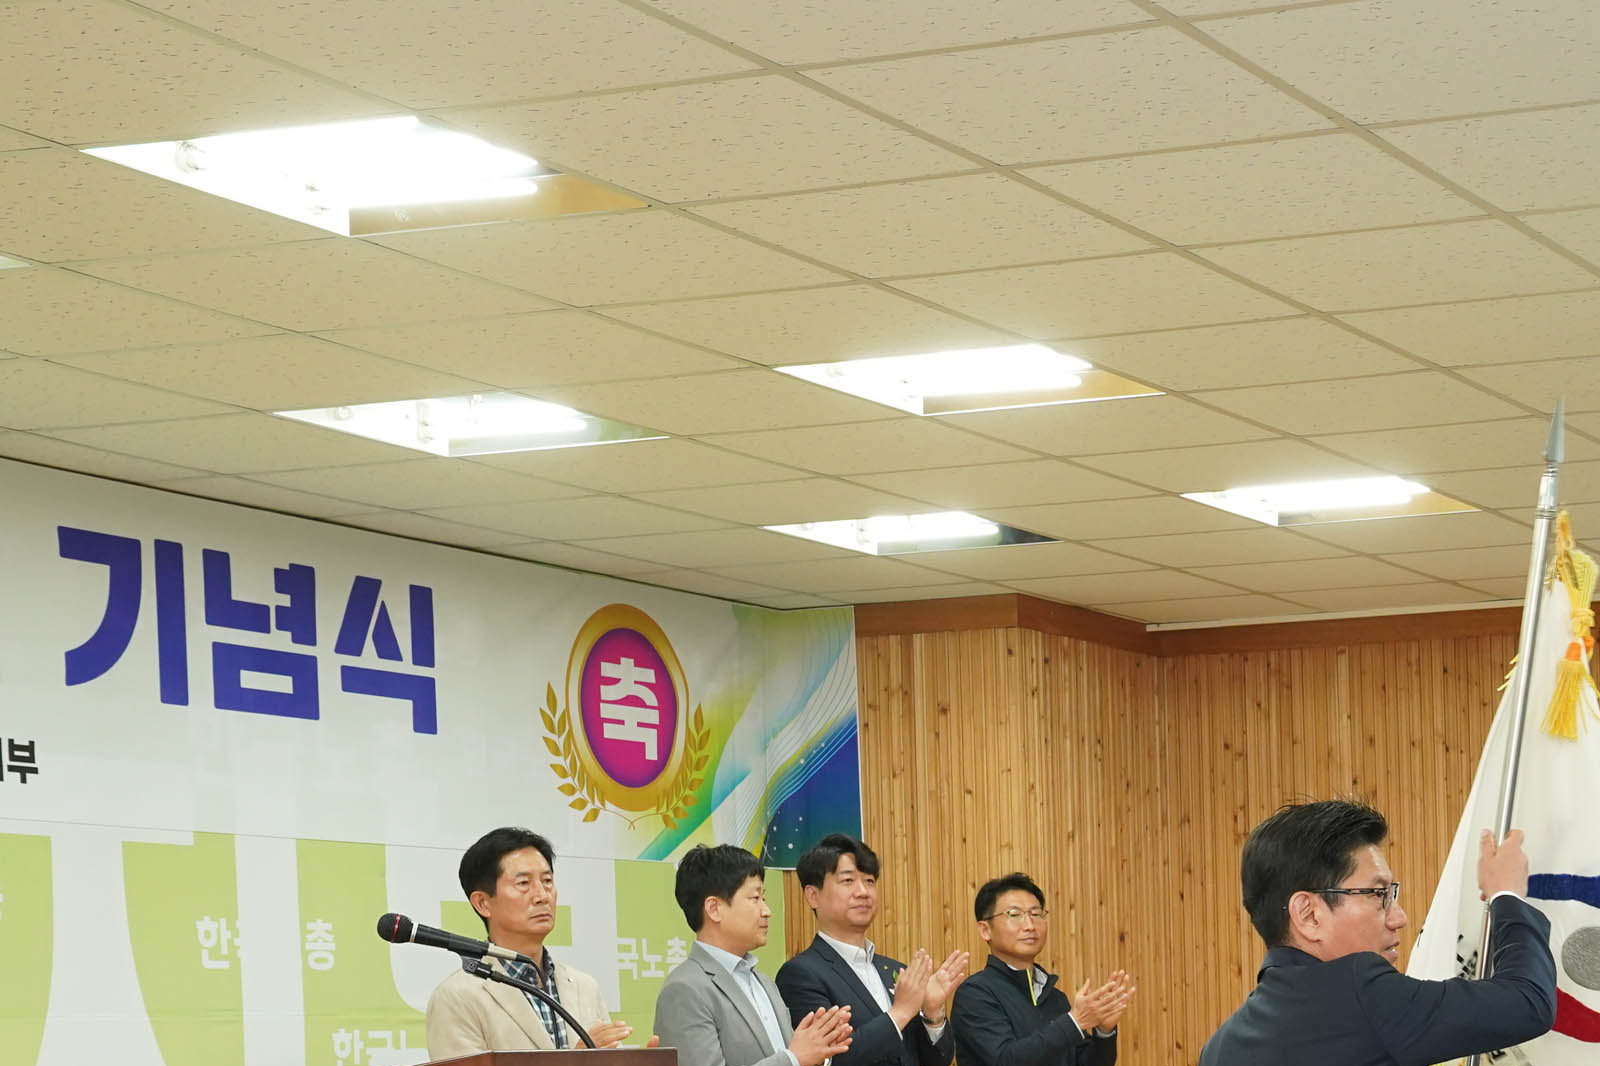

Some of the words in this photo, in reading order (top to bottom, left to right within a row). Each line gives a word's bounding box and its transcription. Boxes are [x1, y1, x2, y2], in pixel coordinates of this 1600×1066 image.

[57, 525, 438, 735] 기념식
[0, 737, 39, 784] 부
[598, 656, 661, 761] 축
